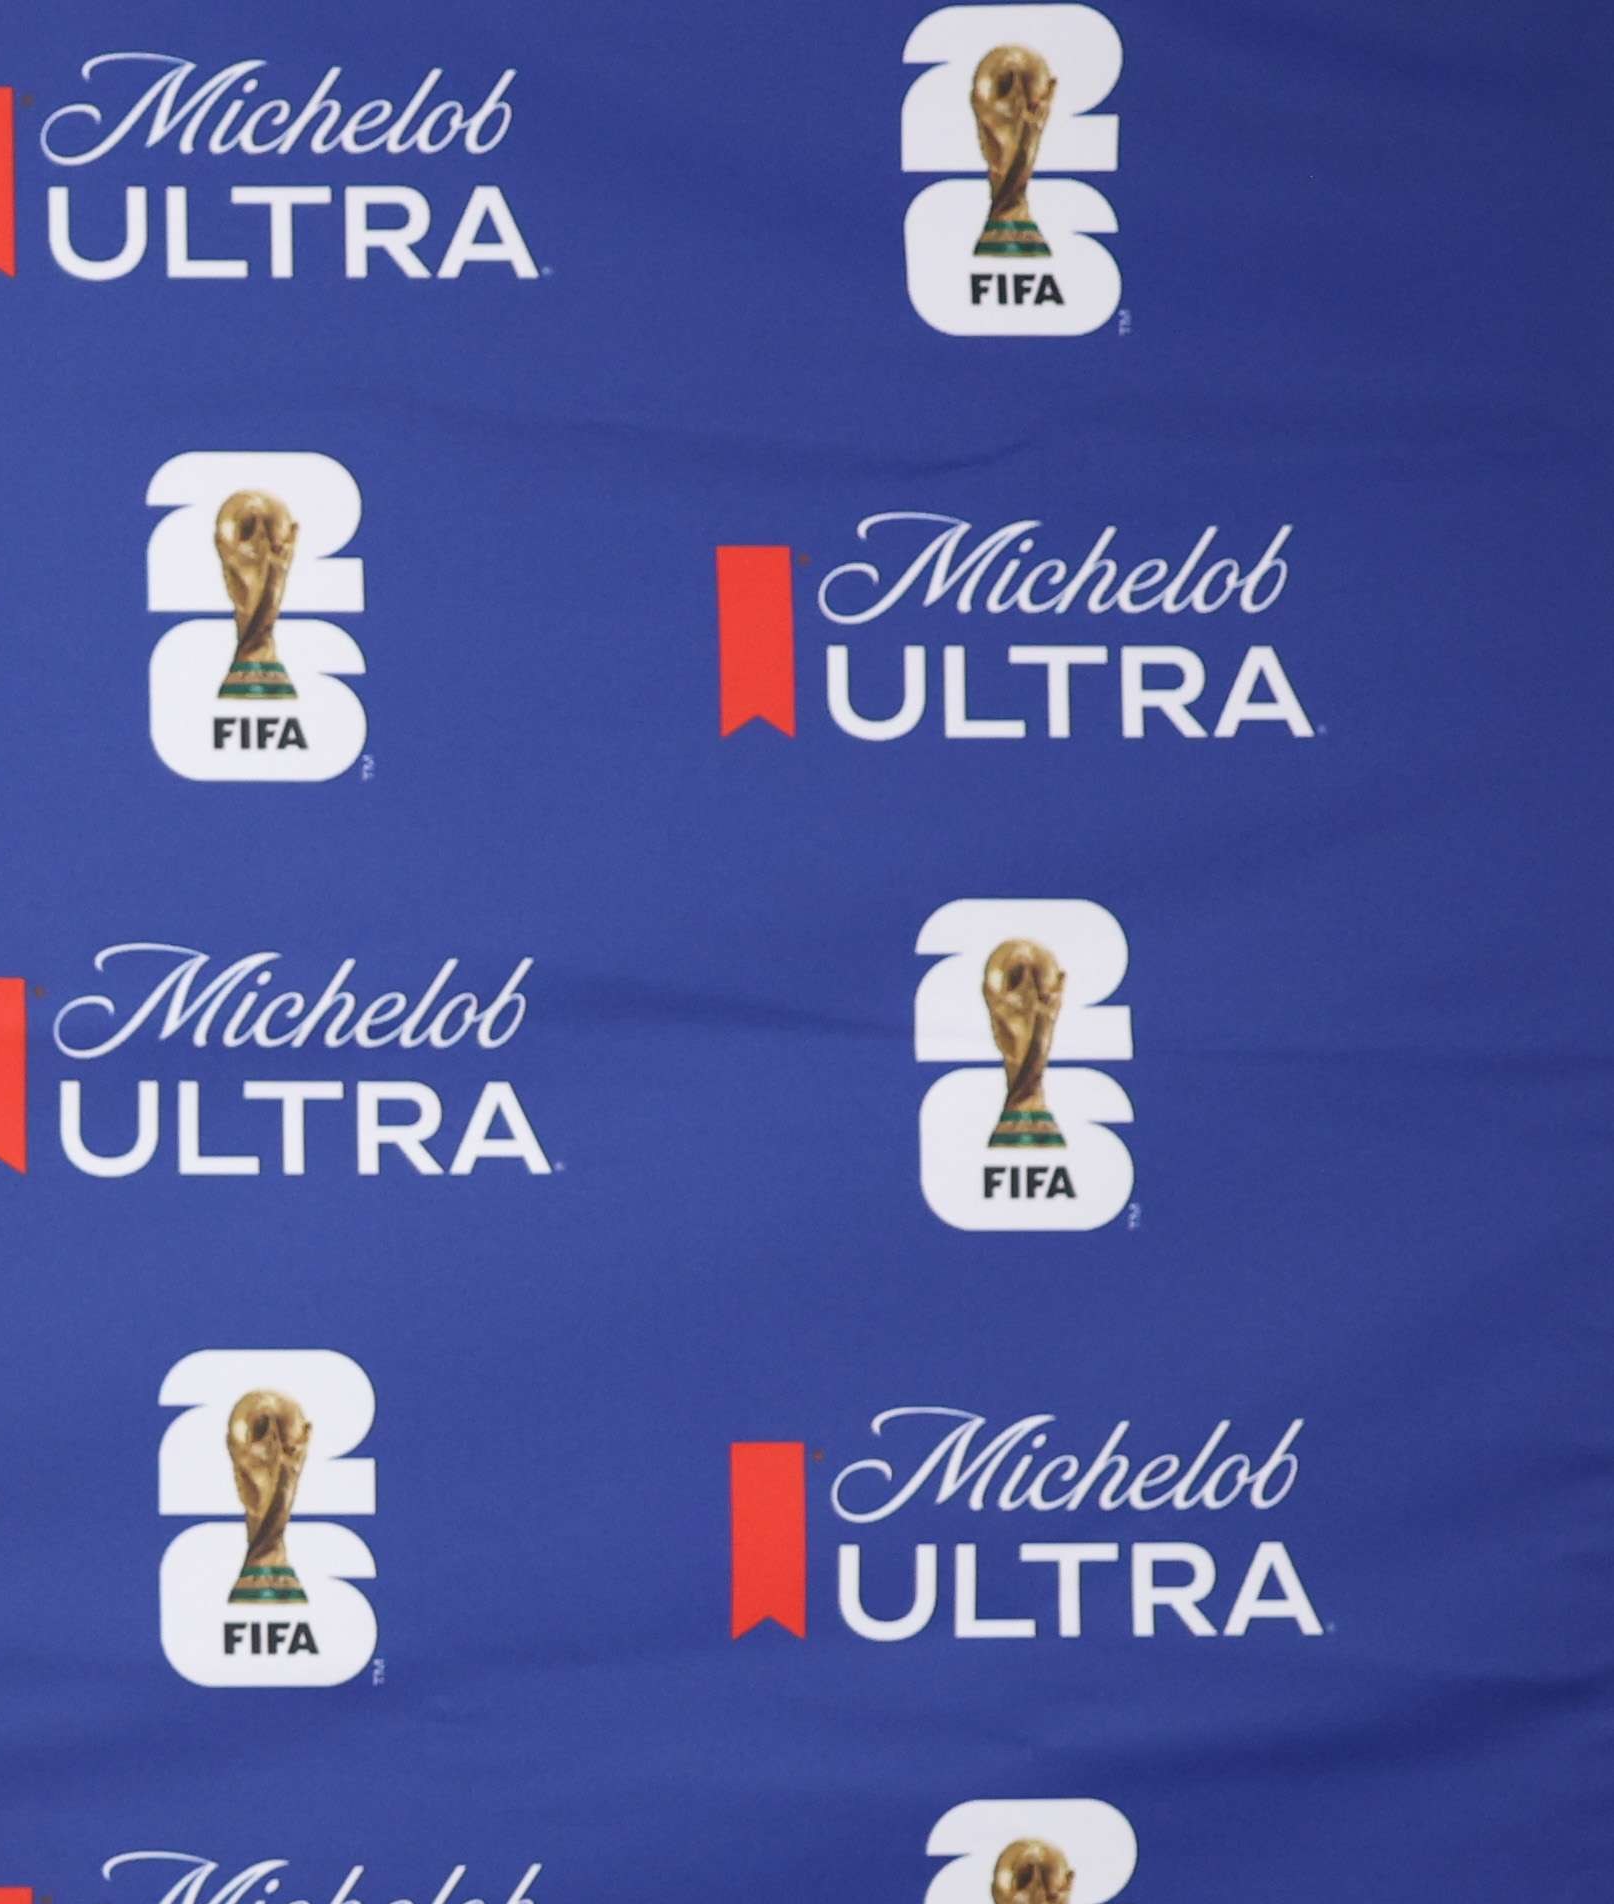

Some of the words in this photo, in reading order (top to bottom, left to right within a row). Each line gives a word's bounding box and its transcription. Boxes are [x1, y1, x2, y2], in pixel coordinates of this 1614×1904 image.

[39, 52, 518, 168] Michelob
[47, 185, 541, 282] ULTRA
[971, 273, 1065, 306] FIFA
[817, 511, 1294, 626] Michelob
[214, 717, 308, 750] FIFA
[825, 644, 1316, 742] ULTRA
[53, 942, 535, 1061] Michelob
[59, 1079, 554, 1178] ULTRA
[984, 1166, 1076, 1199] FIFA
[830, 1406, 1305, 1525] Michelob
[224, 1622, 319, 1655] FIFA
[837, 1541, 1325, 1642] ULTRA
